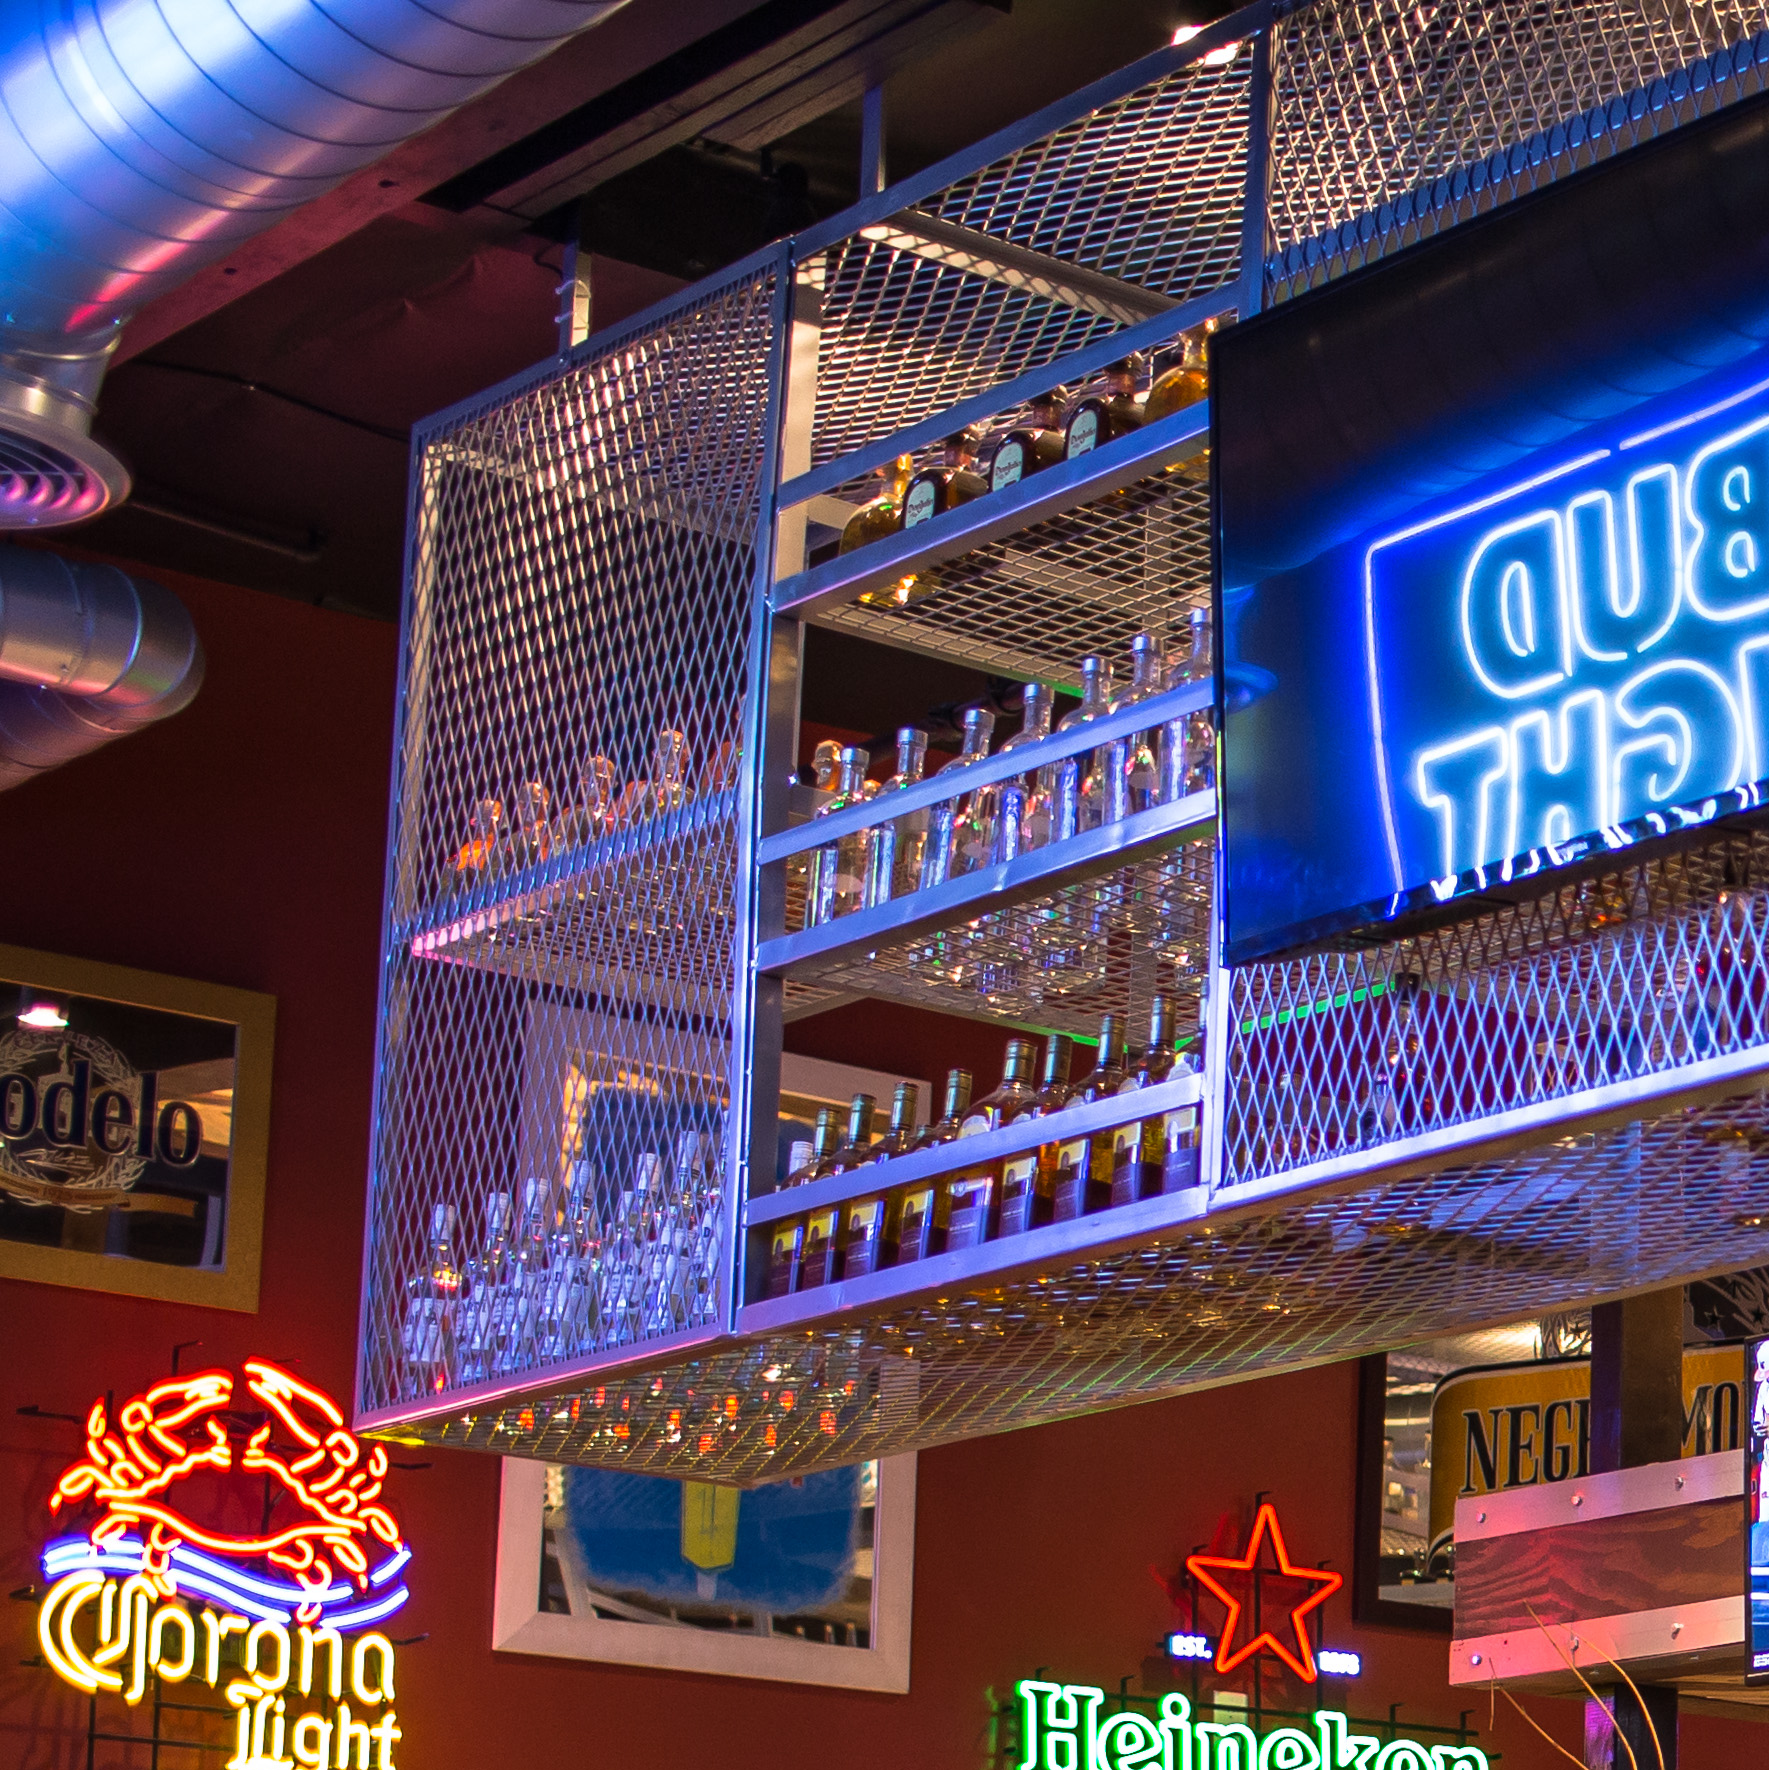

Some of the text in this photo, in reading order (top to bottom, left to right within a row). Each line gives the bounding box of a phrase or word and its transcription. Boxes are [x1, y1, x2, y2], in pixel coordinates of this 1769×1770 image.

[0, 1059, 203, 1167] odelo
[1461, 1398, 1591, 1494] NEG
[39, 1568, 396, 1706] Corona
